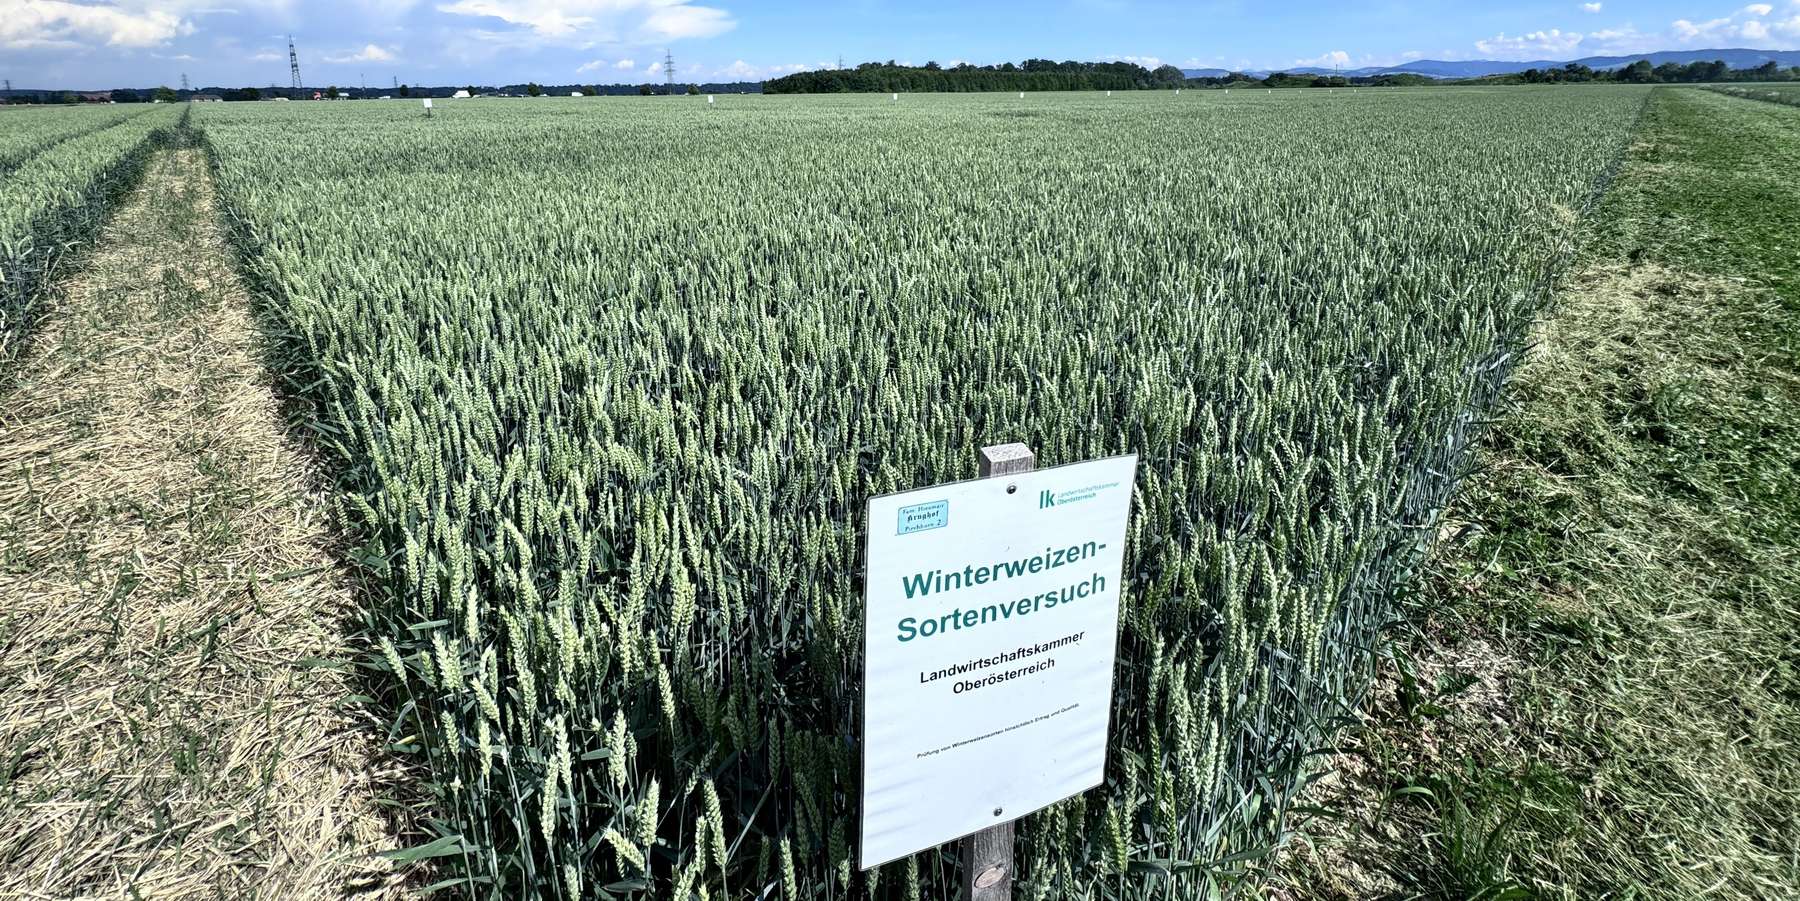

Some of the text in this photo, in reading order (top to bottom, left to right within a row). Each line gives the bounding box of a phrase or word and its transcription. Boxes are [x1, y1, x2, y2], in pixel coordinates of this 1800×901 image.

[1039, 489, 1056, 510] lk
[1056, 492, 1097, 506] Oberösterreich
[1057, 482, 1120, 498] Landwirtschaftskammer
[902, 540, 1107, 600] Winterweizen-
[897, 572, 1106, 643] Sortenversuch
[919, 630, 1085, 684] Landwirtschaftskammer
[952, 657, 1056, 694] Oberösterreich
[916, 748, 940, 759] Prüfung
[951, 729, 1004, 749] Winterweizensorten
[1034, 713, 1050, 722] Ertrag
[1050, 709, 1060, 717] und
